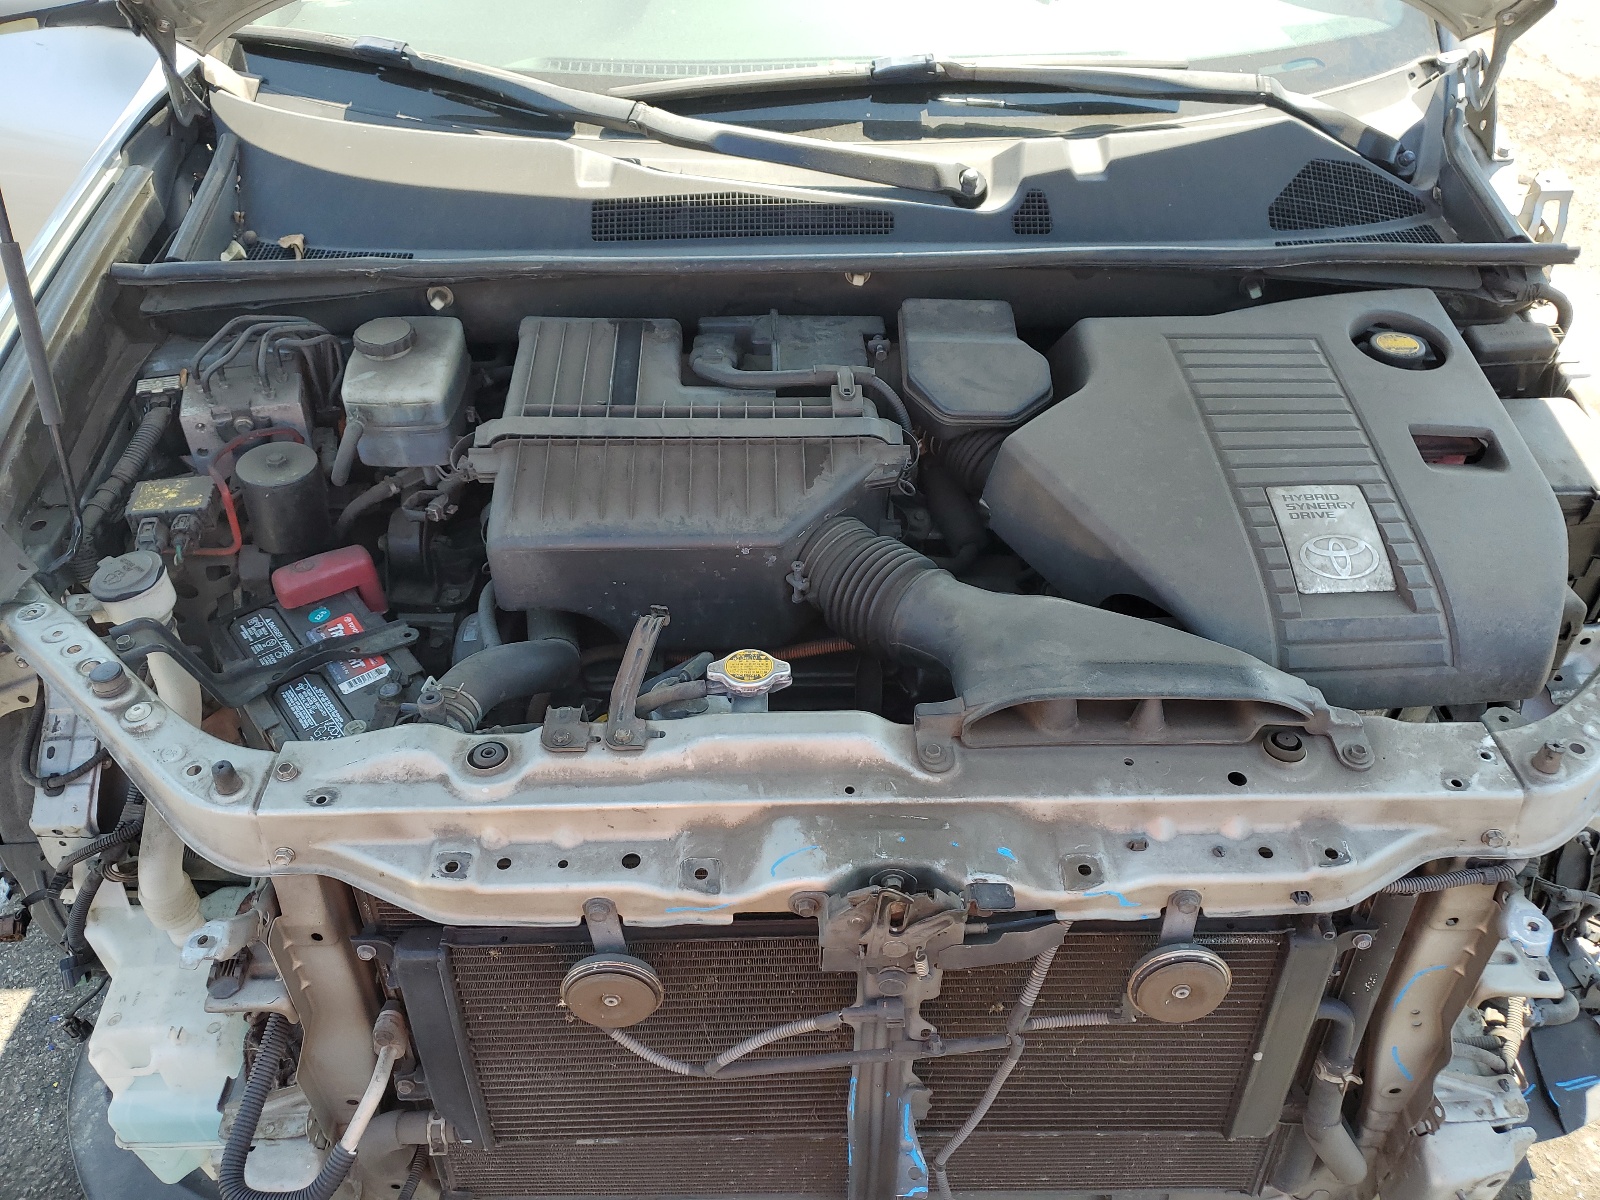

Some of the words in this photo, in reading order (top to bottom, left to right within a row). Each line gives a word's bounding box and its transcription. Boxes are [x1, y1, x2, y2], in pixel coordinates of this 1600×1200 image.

[1281, 493, 1340, 501] HYBRID
[1285, 501, 1356, 511] SYNERGY
[1289, 511, 1337, 520] DRIVE
[347, 620, 360, 634] TOYO
